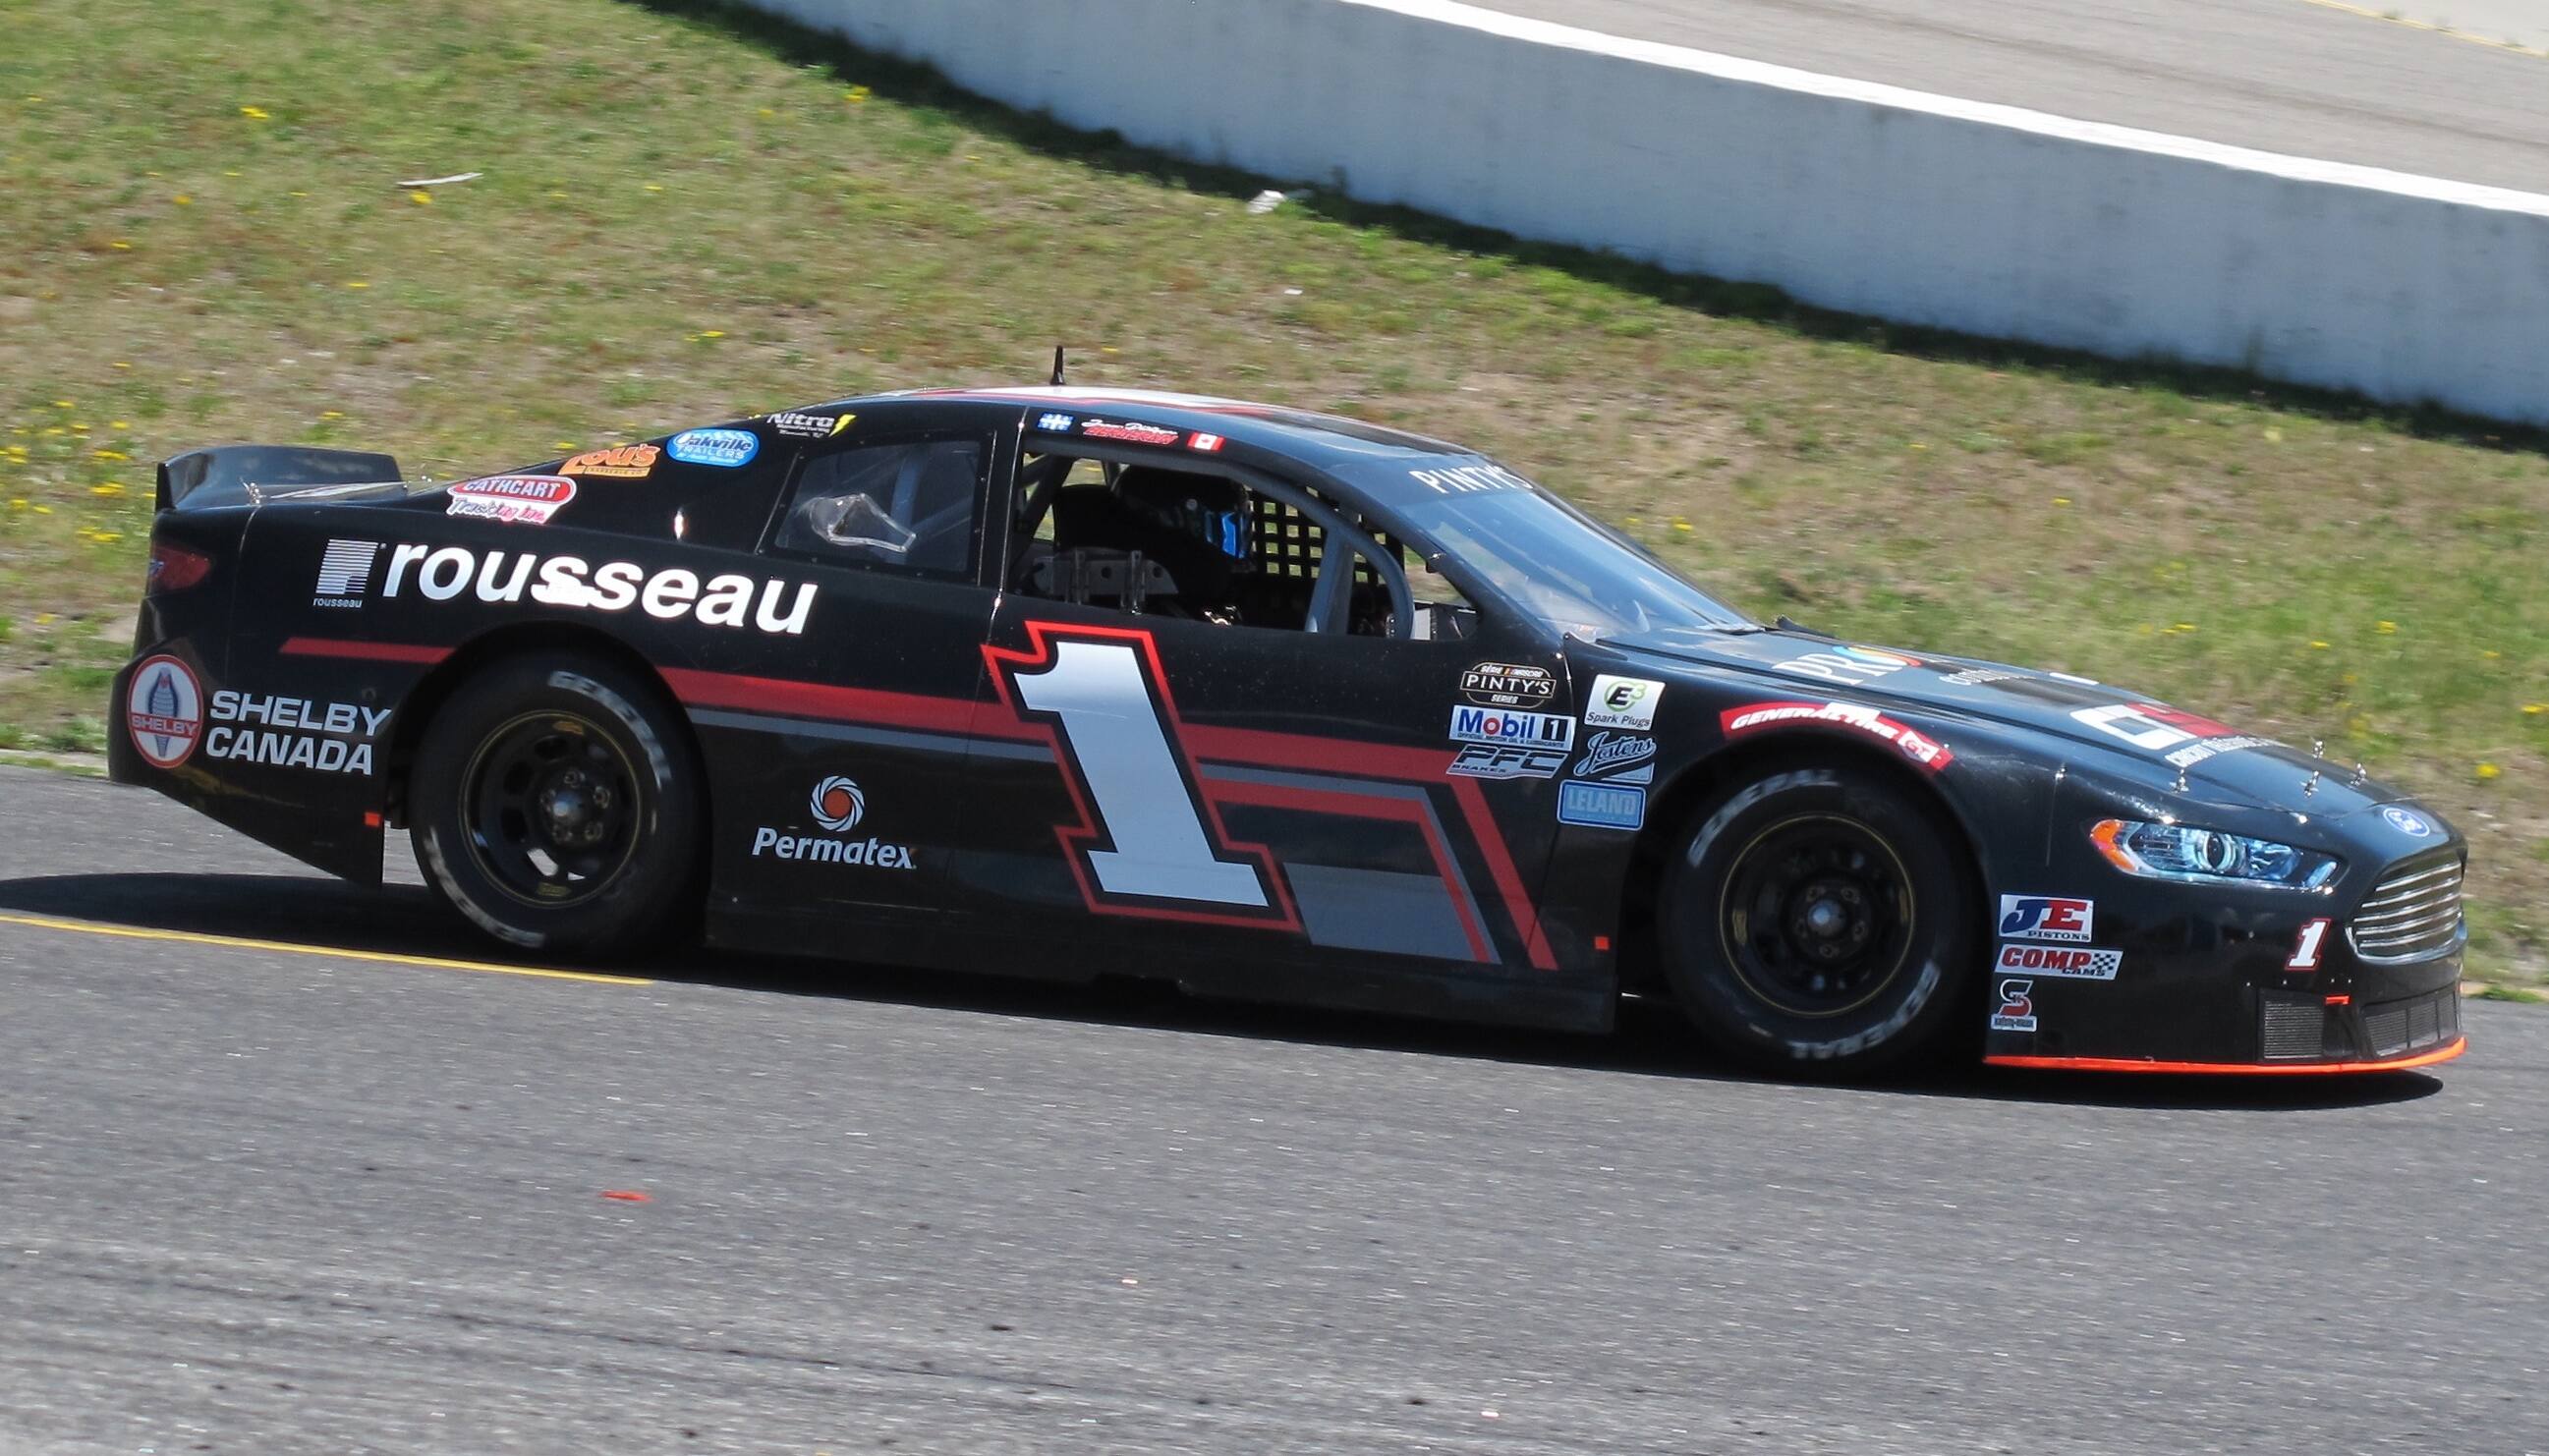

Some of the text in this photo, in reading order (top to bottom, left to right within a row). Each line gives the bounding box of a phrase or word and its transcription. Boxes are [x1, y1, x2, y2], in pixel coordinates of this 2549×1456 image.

[766, 413, 834, 427] Nitro
[462, 478, 561, 498] CATHCART
[382, 543, 818, 635] rousseau
[312, 597, 363, 609] rousseau
[1465, 675, 1552, 696] PINTY'S
[132, 713, 199, 737] SHELBY
[209, 690, 391, 737] SHELBY
[1457, 708, 1536, 739] Mobil
[1586, 711, 1651, 728] Spark Plugs
[205, 726, 372, 776] CANADA
[1456, 746, 1567, 772] PFC
[1574, 731, 1656, 776] Jostens
[1013, 642, 1270, 907] 1
[1569, 789, 1636, 814] LELAND
[751, 827, 914, 869] Permatex
[2001, 899, 2088, 933] JE
[2027, 929, 2090, 941] PISTONS
[2288, 921, 2327, 967] 1
[2001, 947, 2091, 970] COMP
[2062, 967, 2106, 977] CAMS
